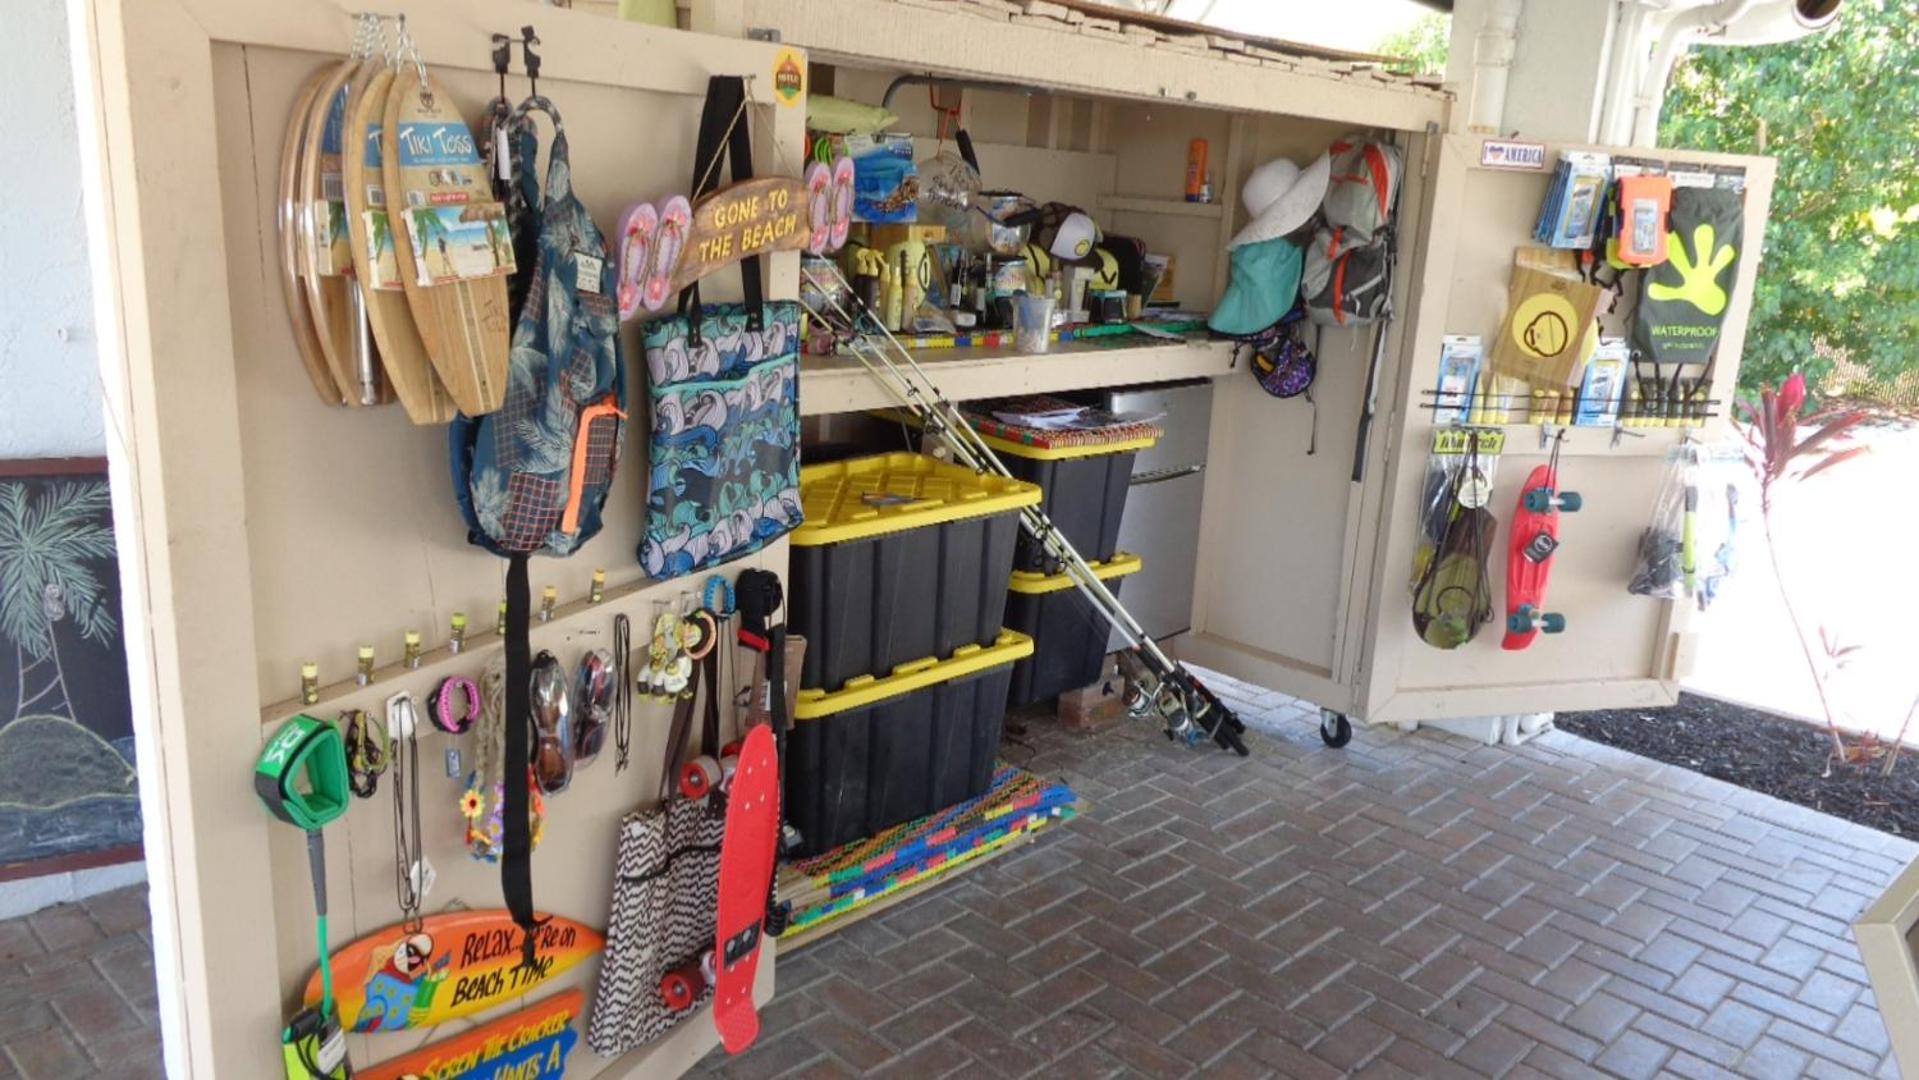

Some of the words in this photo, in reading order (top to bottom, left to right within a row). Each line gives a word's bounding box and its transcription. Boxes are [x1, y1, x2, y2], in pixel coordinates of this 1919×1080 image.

[400, 126, 432, 156] TIKI
[433, 126, 472, 155] TOSS
[1504, 147, 1542, 164] AMERICA
[714, 196, 759, 228] GONE
[768, 188, 788, 211] TO
[700, 234, 733, 262] THE
[741, 214, 797, 251] BEACH
[1651, 325, 1718, 337] WATERPROOF
